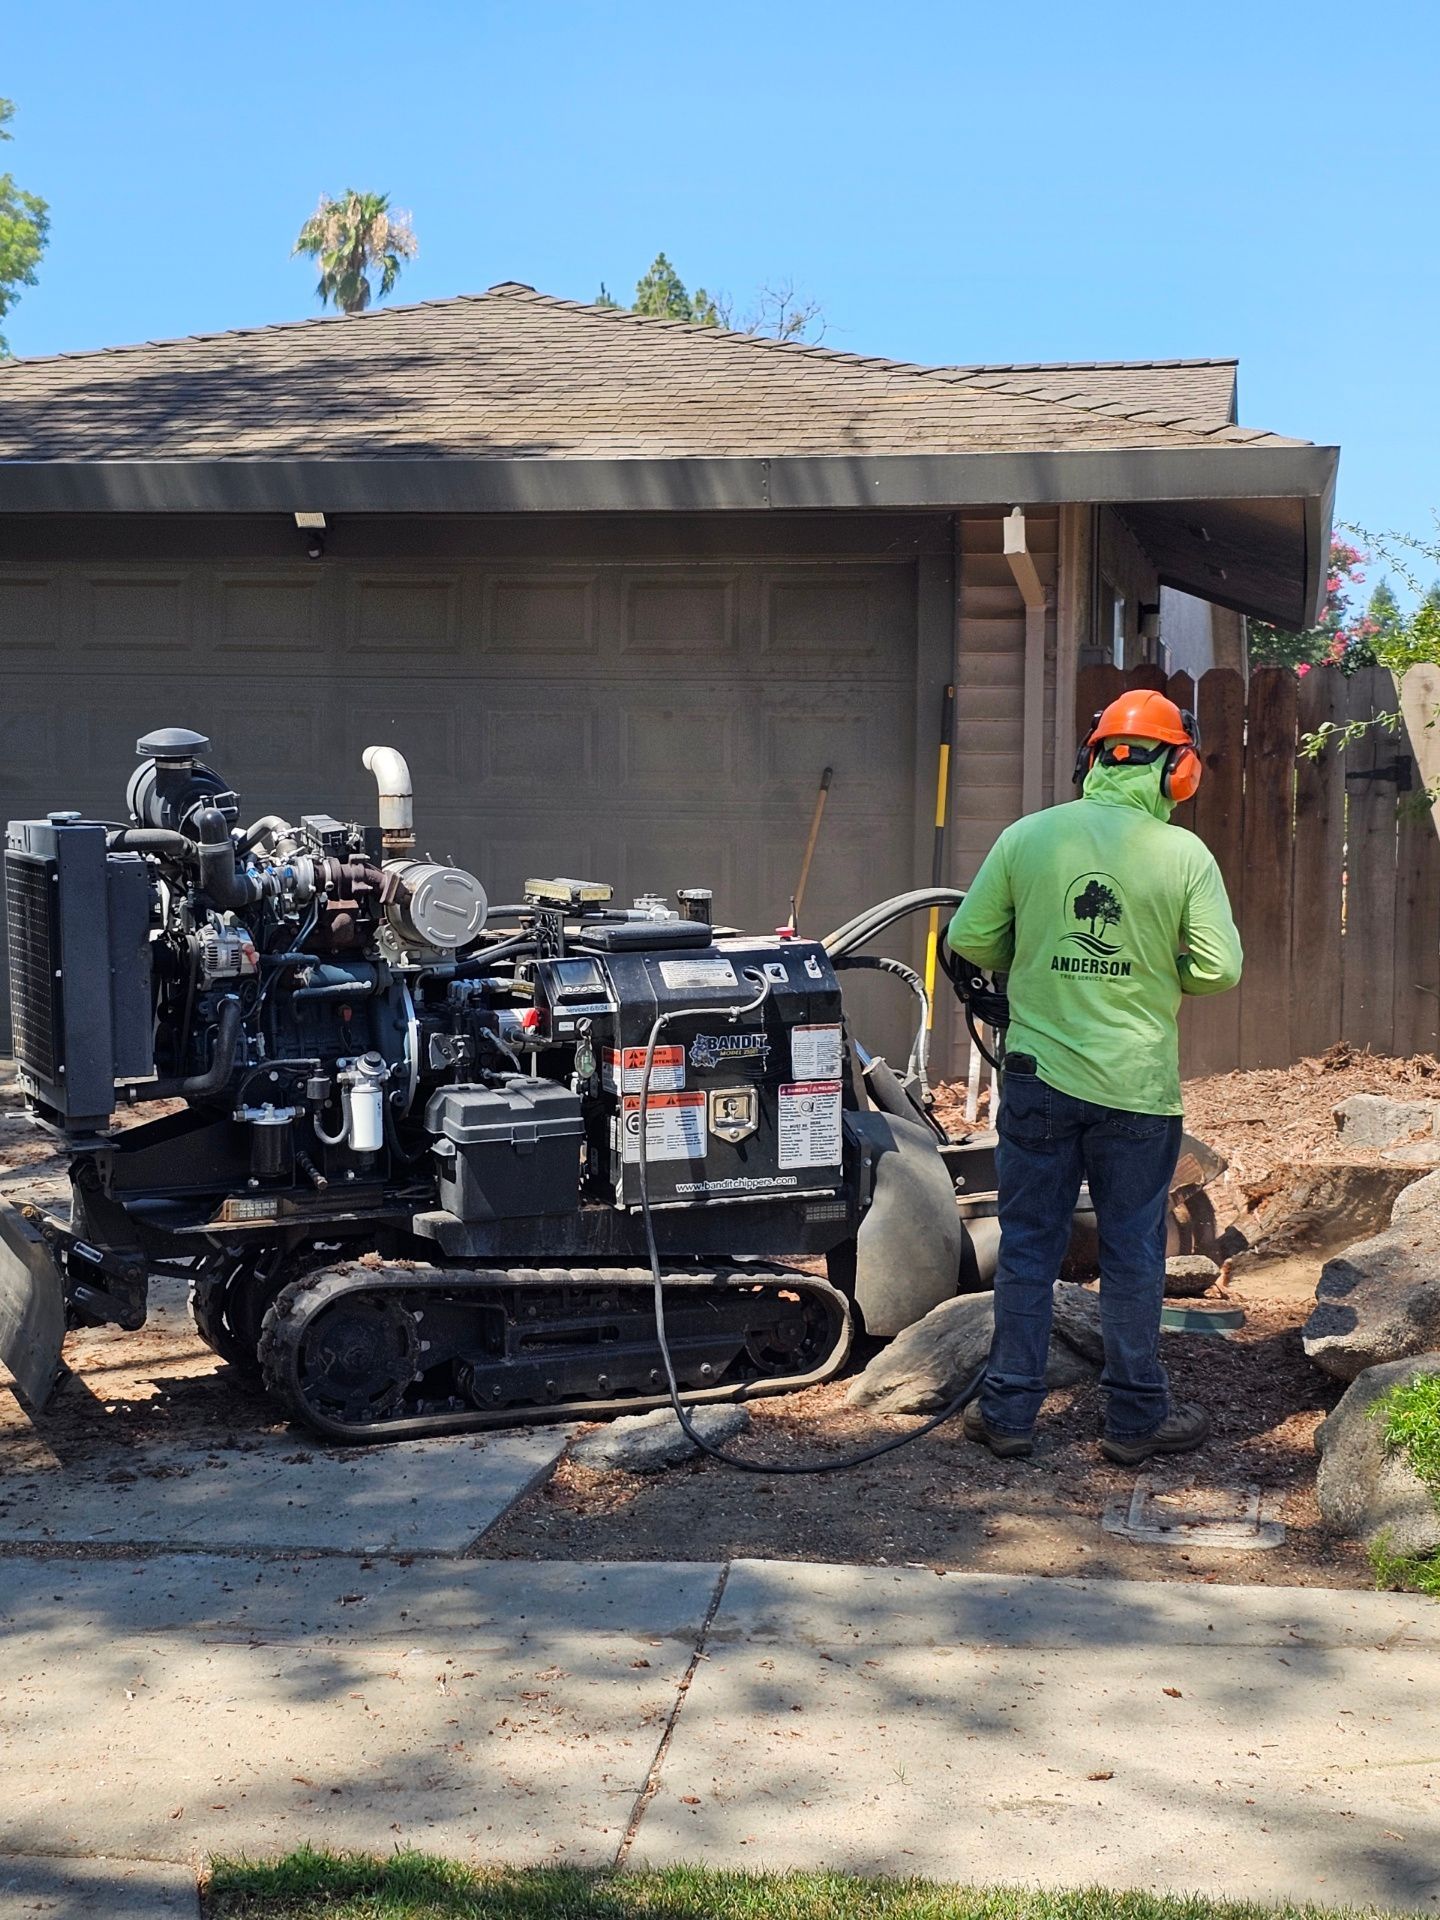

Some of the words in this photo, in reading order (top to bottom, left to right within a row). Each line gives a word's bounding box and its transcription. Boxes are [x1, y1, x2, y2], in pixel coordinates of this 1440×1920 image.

[1051, 956, 1131, 976] ANDERSON
[706, 1034, 767, 1050] BANDIT
[676, 1176, 797, 1193] www.banditchippers.com
